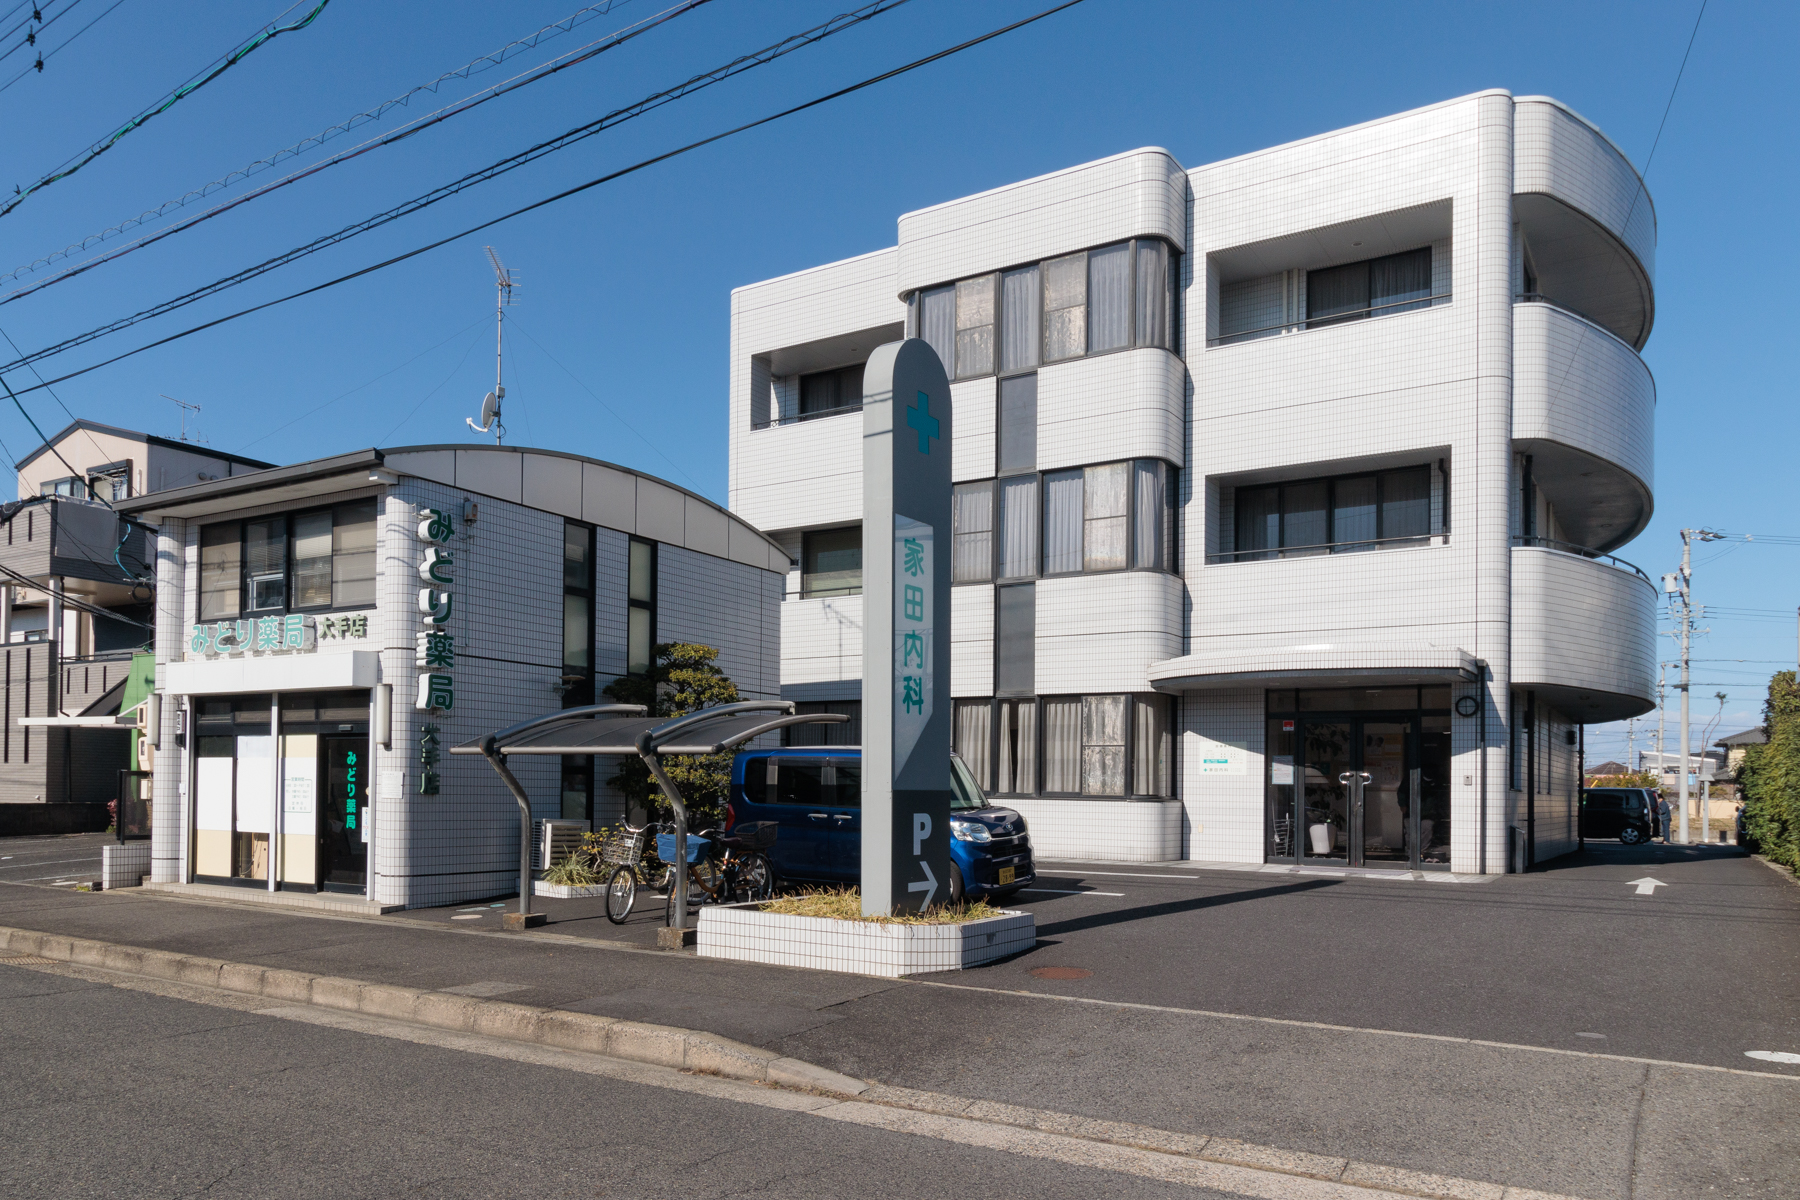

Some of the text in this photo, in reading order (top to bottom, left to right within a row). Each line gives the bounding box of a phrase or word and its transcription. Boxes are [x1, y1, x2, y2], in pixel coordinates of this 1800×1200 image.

[191, 613, 304, 654] みどり薬局
[319, 614, 368, 640] 大手店
[420, 507, 455, 711] みどり薬局
[903, 537, 924, 716] 家田内科
[346, 751, 357, 829] みどり薬局
[420, 722, 441, 795] 大手店
[913, 812, 932, 855] P
